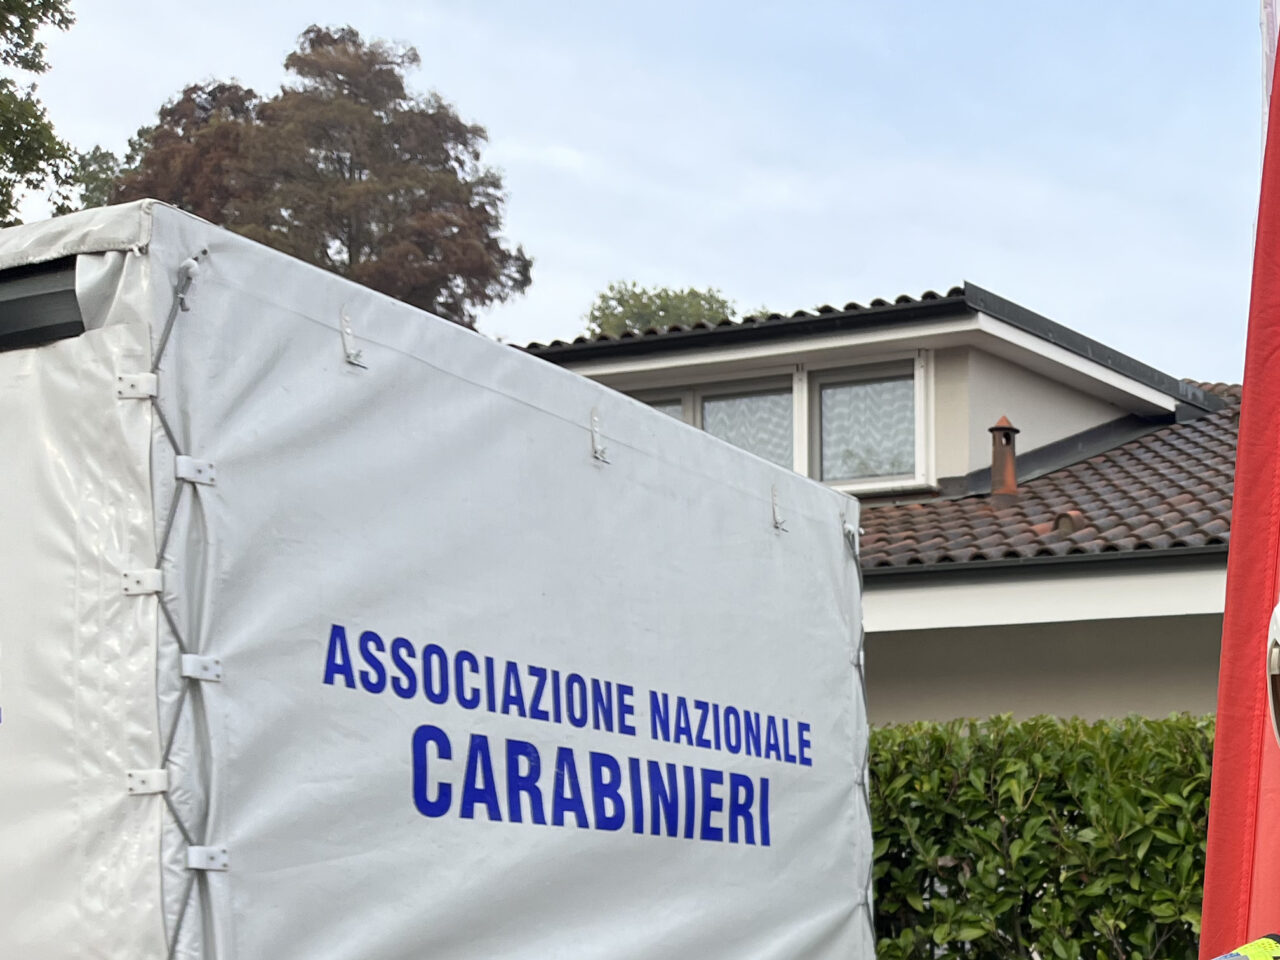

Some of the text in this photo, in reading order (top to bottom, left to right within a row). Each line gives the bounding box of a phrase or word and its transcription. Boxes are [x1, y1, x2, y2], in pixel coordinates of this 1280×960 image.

[323, 623, 814, 767] ASSOCIAZIONE NAZIONALE
[411, 724, 771, 846] CARABINIERI
